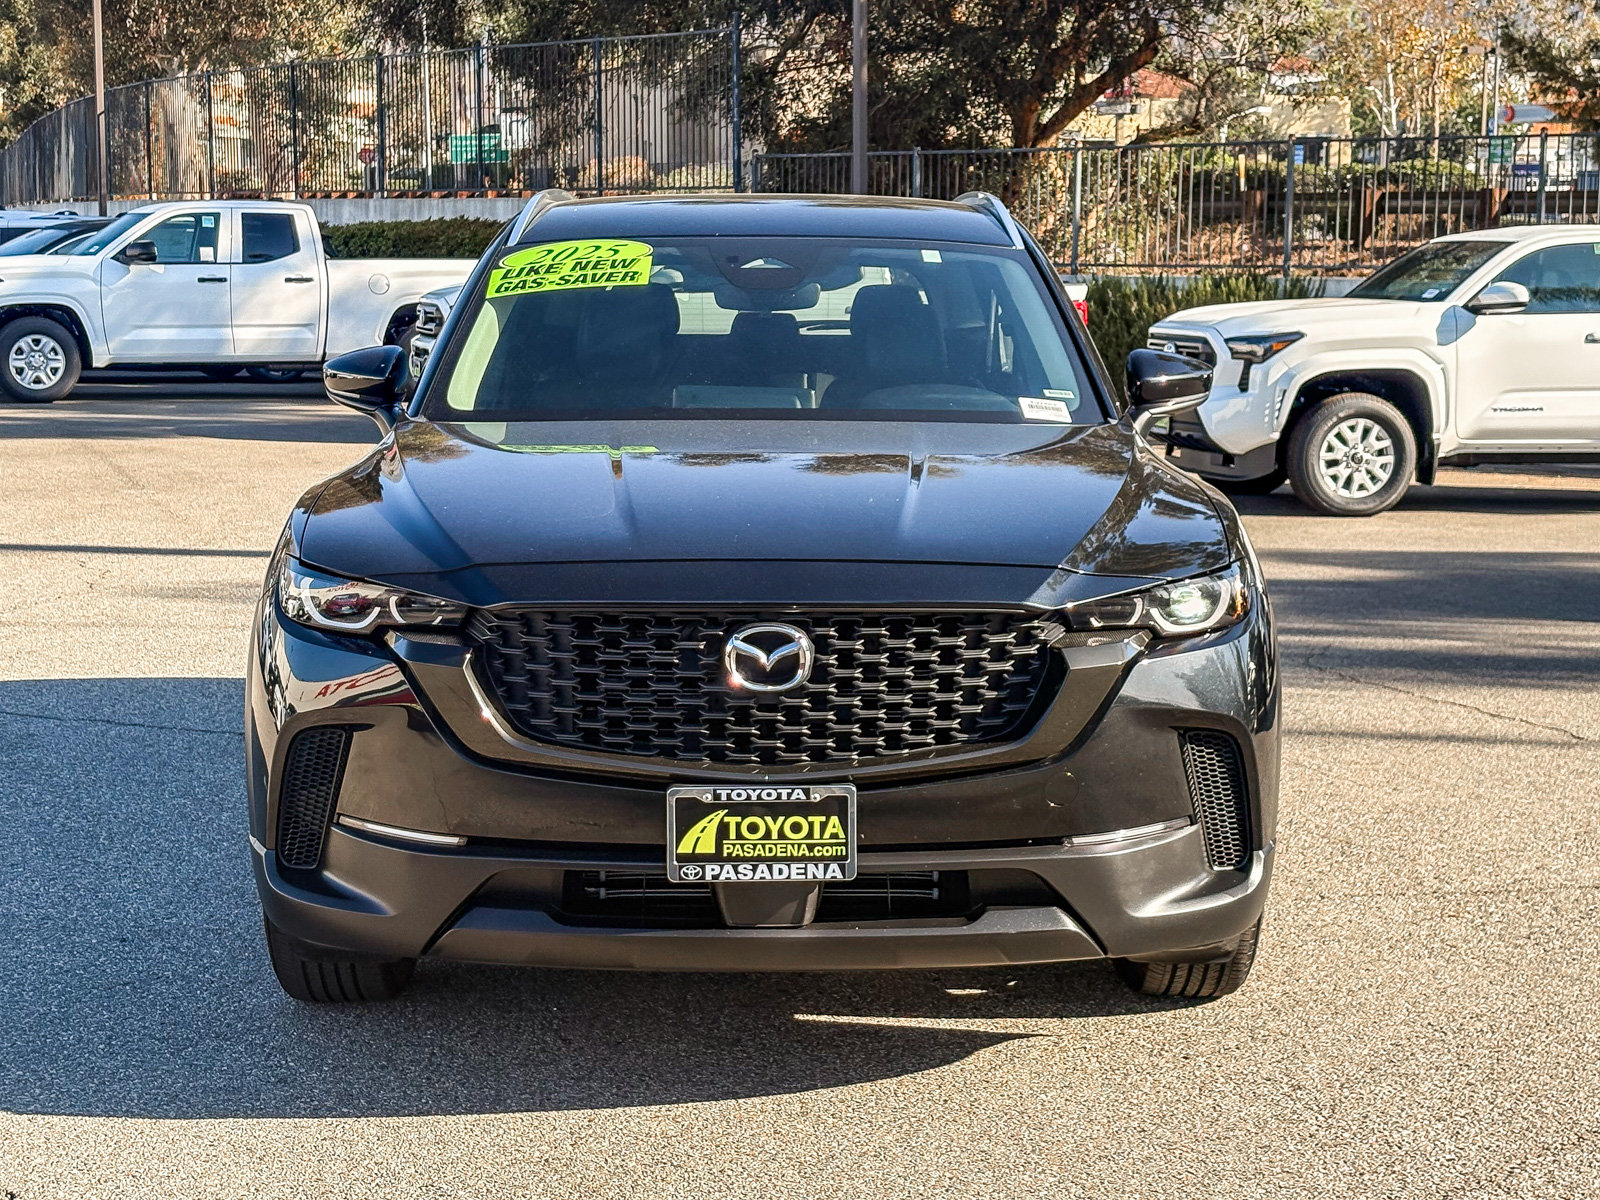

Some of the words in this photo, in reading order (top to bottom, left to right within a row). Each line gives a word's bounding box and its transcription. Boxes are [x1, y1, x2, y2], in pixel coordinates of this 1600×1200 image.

[525, 243, 629, 266] 2025
[500, 262, 566, 281] LIKE
[570, 257, 641, 272] NEW
[494, 271, 642, 294] GAS-SAVER
[717, 788, 807, 801] TOYOTA
[723, 815, 846, 840] TOYOTA
[723, 844, 846, 857] PASADENA.com
[705, 863, 844, 880] PASADENA
